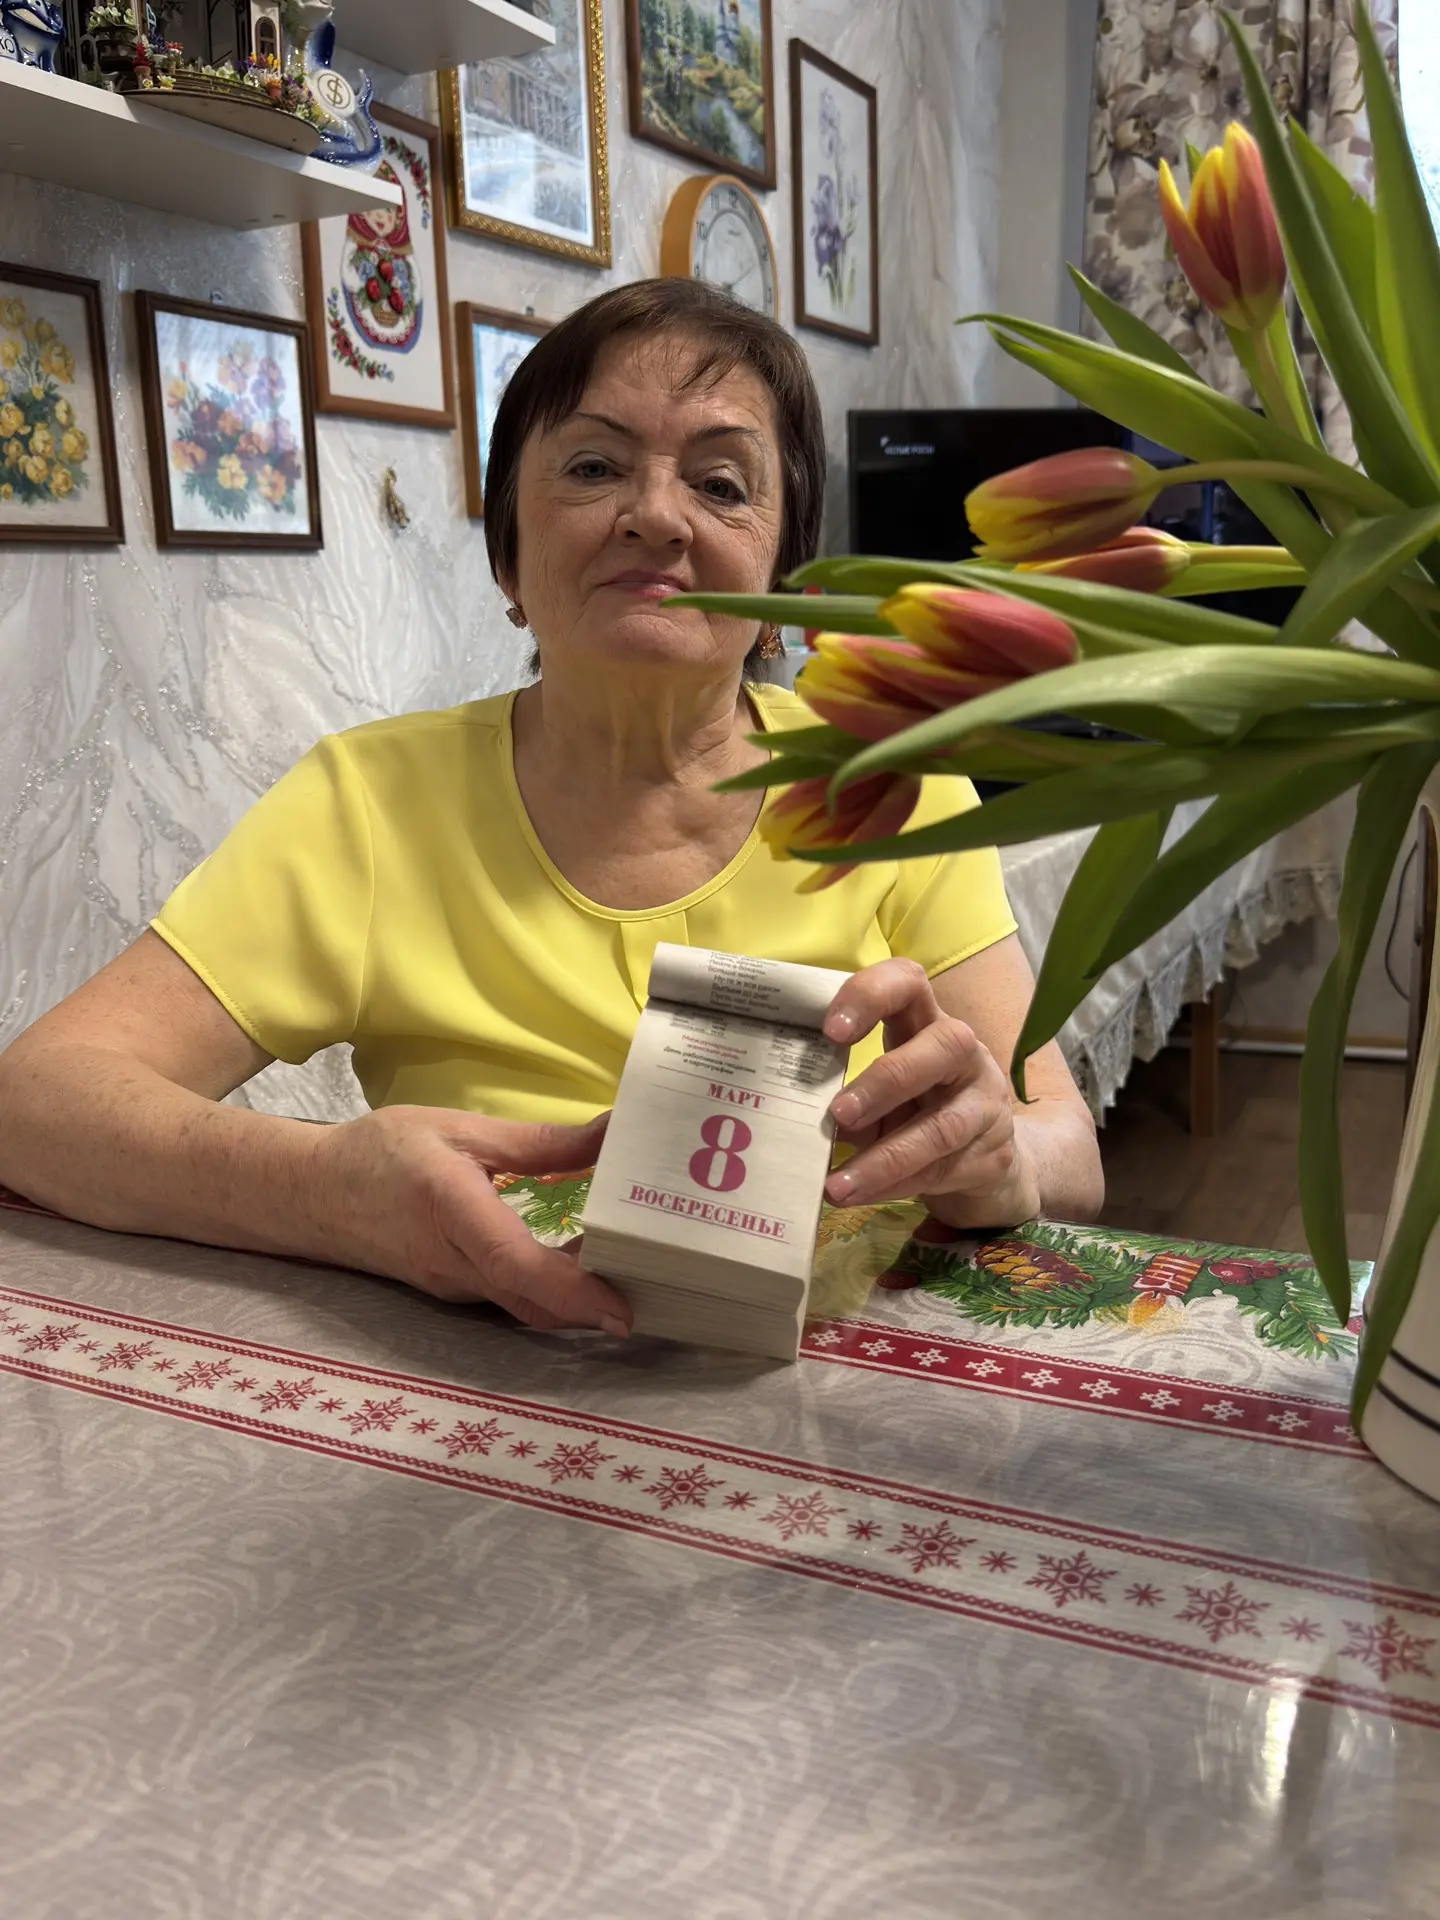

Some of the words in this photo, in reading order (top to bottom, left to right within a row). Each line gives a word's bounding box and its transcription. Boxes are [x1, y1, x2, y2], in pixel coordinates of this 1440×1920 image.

[696, 220, 708, 241] 10
[707, 1083, 766, 1109] МАРТ
[688, 1114, 752, 1193] 8
[629, 1184, 787, 1239] ВОСКРЕСЕНЬЕ
